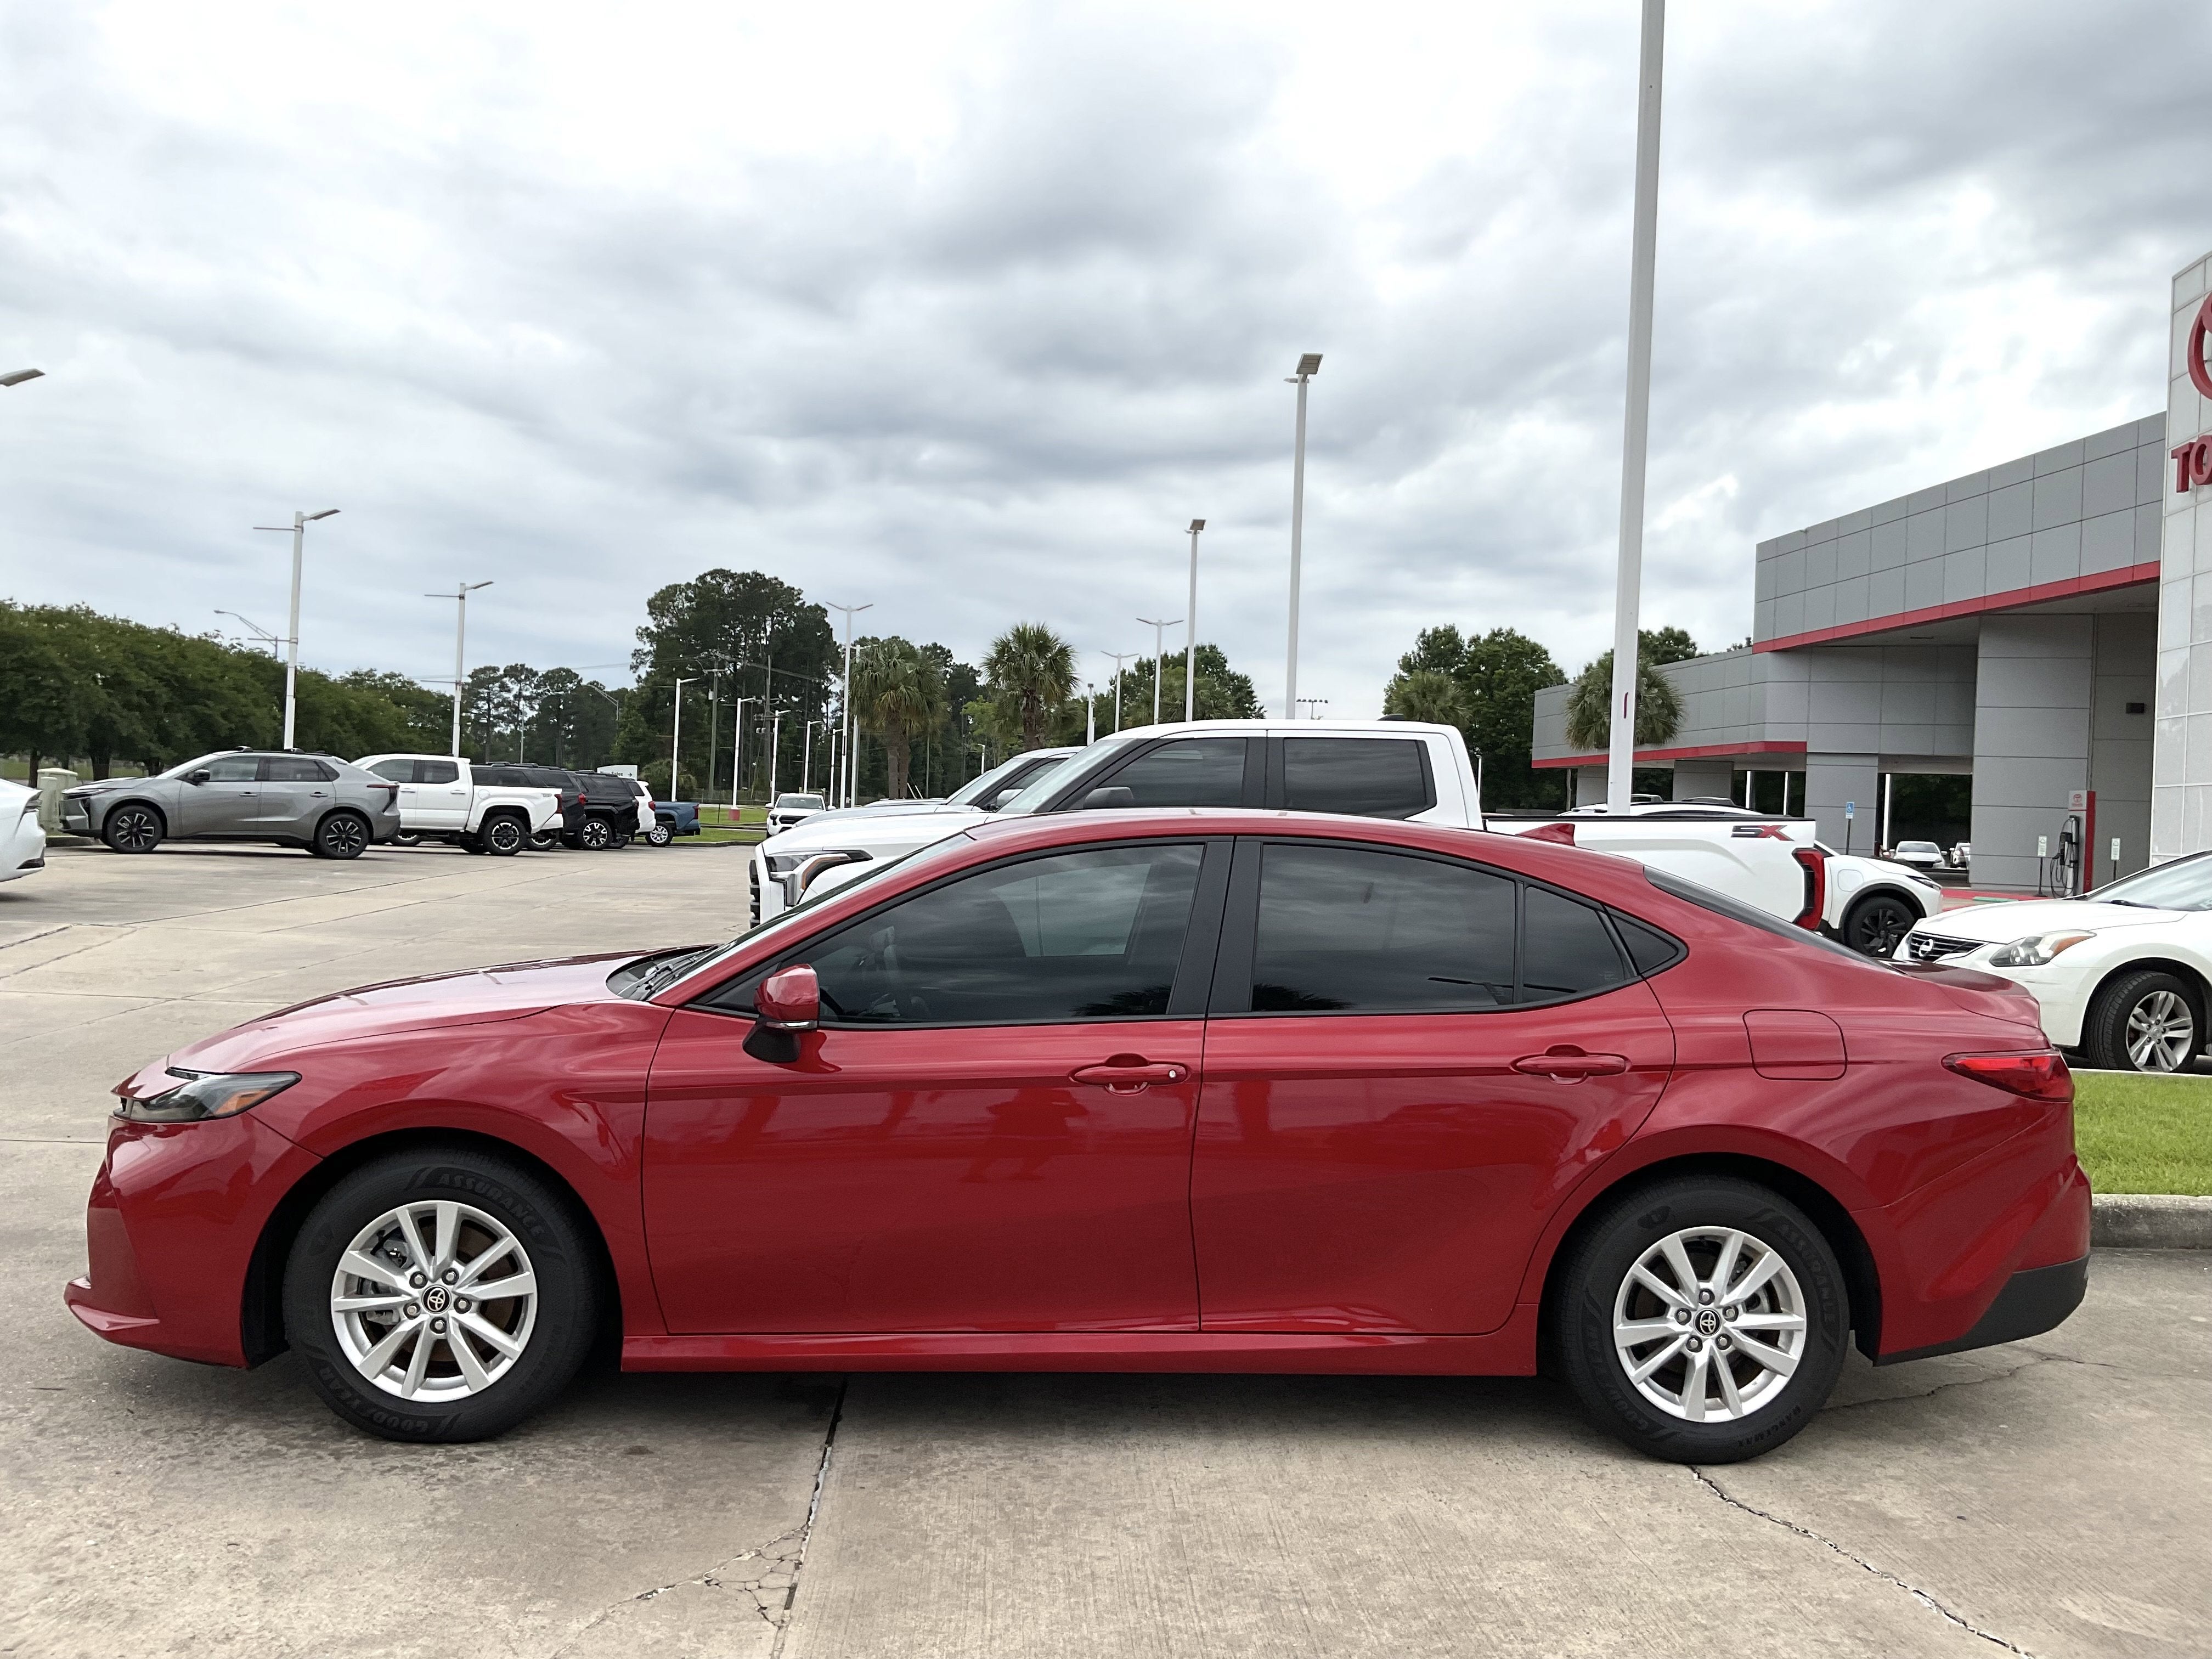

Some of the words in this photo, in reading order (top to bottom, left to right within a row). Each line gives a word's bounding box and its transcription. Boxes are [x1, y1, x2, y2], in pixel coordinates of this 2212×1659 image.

[2171, 435, 2212, 493] TO
[1731, 825, 1795, 842] SX
[437, 1173, 545, 1235] ASSURANCE
